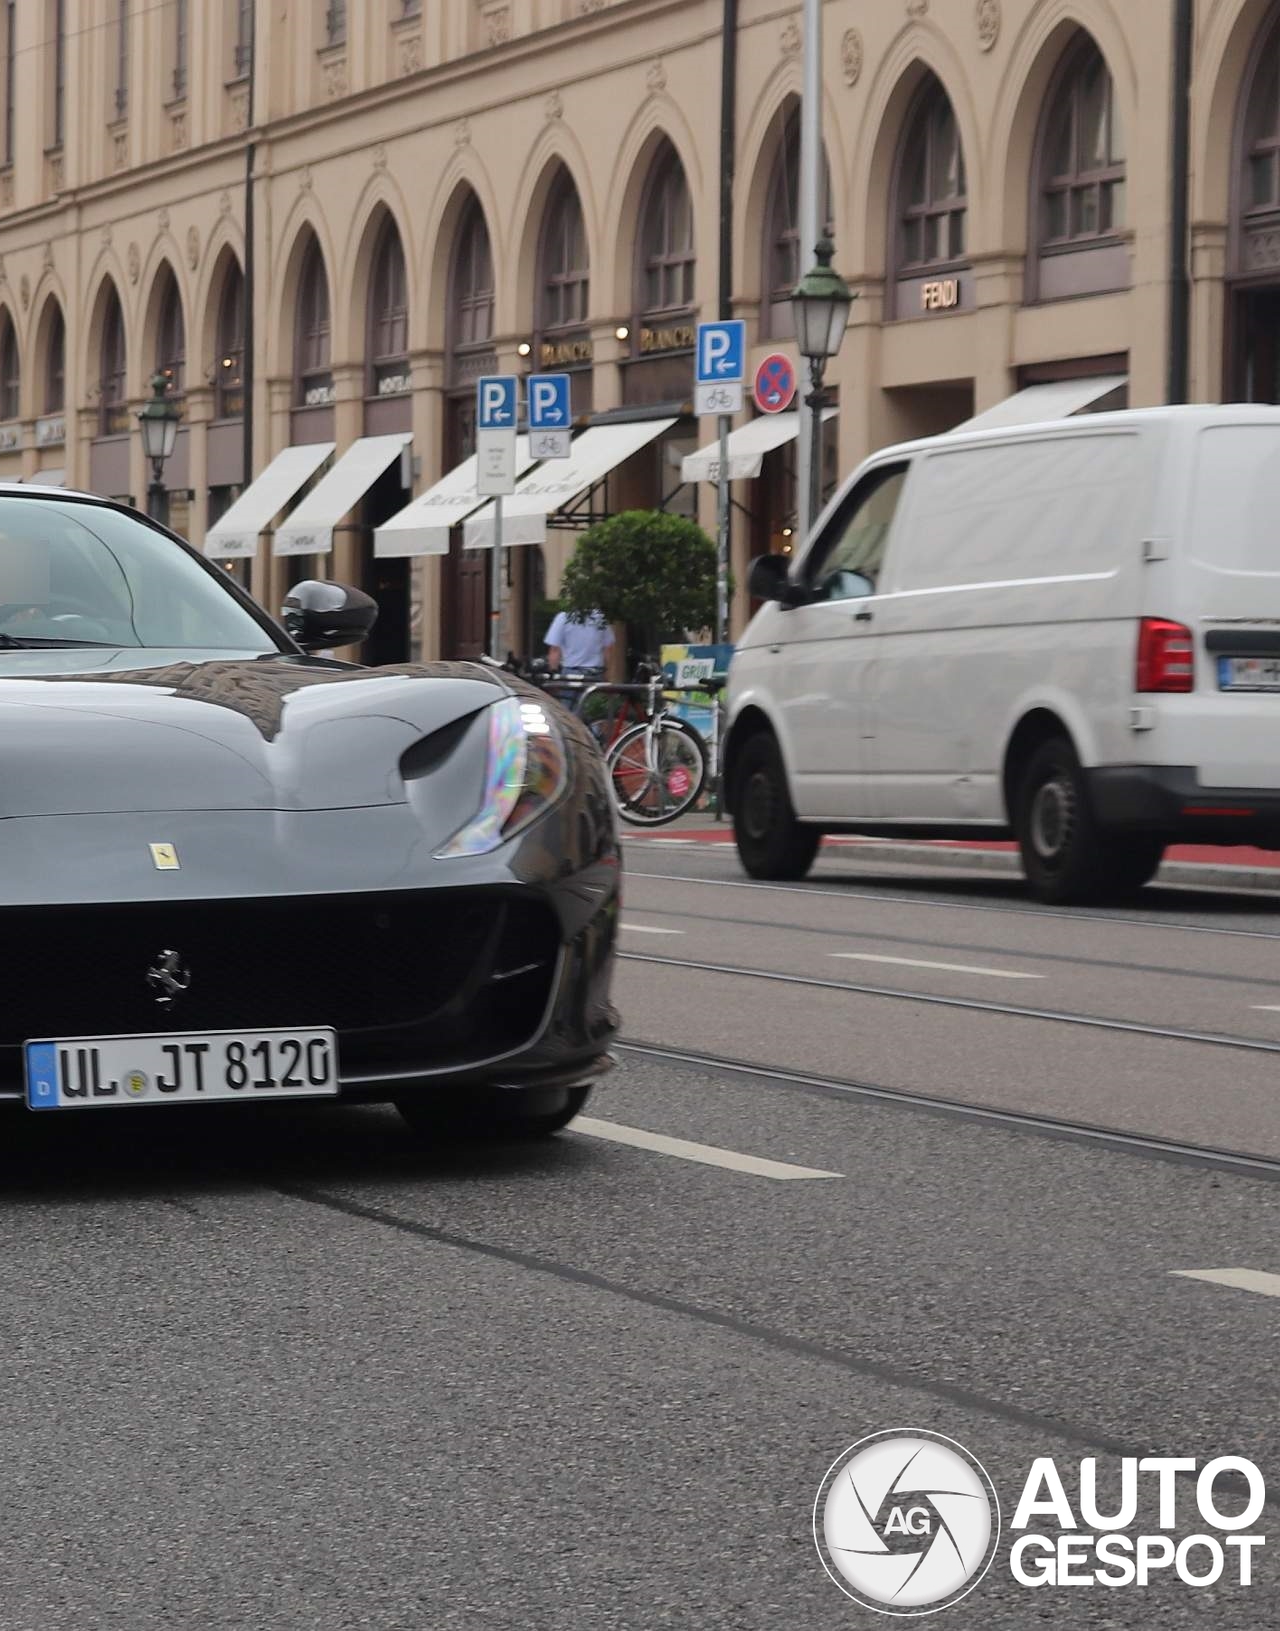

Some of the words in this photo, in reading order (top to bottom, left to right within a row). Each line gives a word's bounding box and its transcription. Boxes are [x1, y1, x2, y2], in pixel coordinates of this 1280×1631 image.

[923, 280, 958, 309] FENDI
[704, 330, 731, 375] P
[484, 383, 506, 423] P
[534, 382, 558, 422] P
[60, 1048, 118, 1098] UL
[157, 1043, 210, 1093] JT
[225, 1038, 330, 1091] 8120
